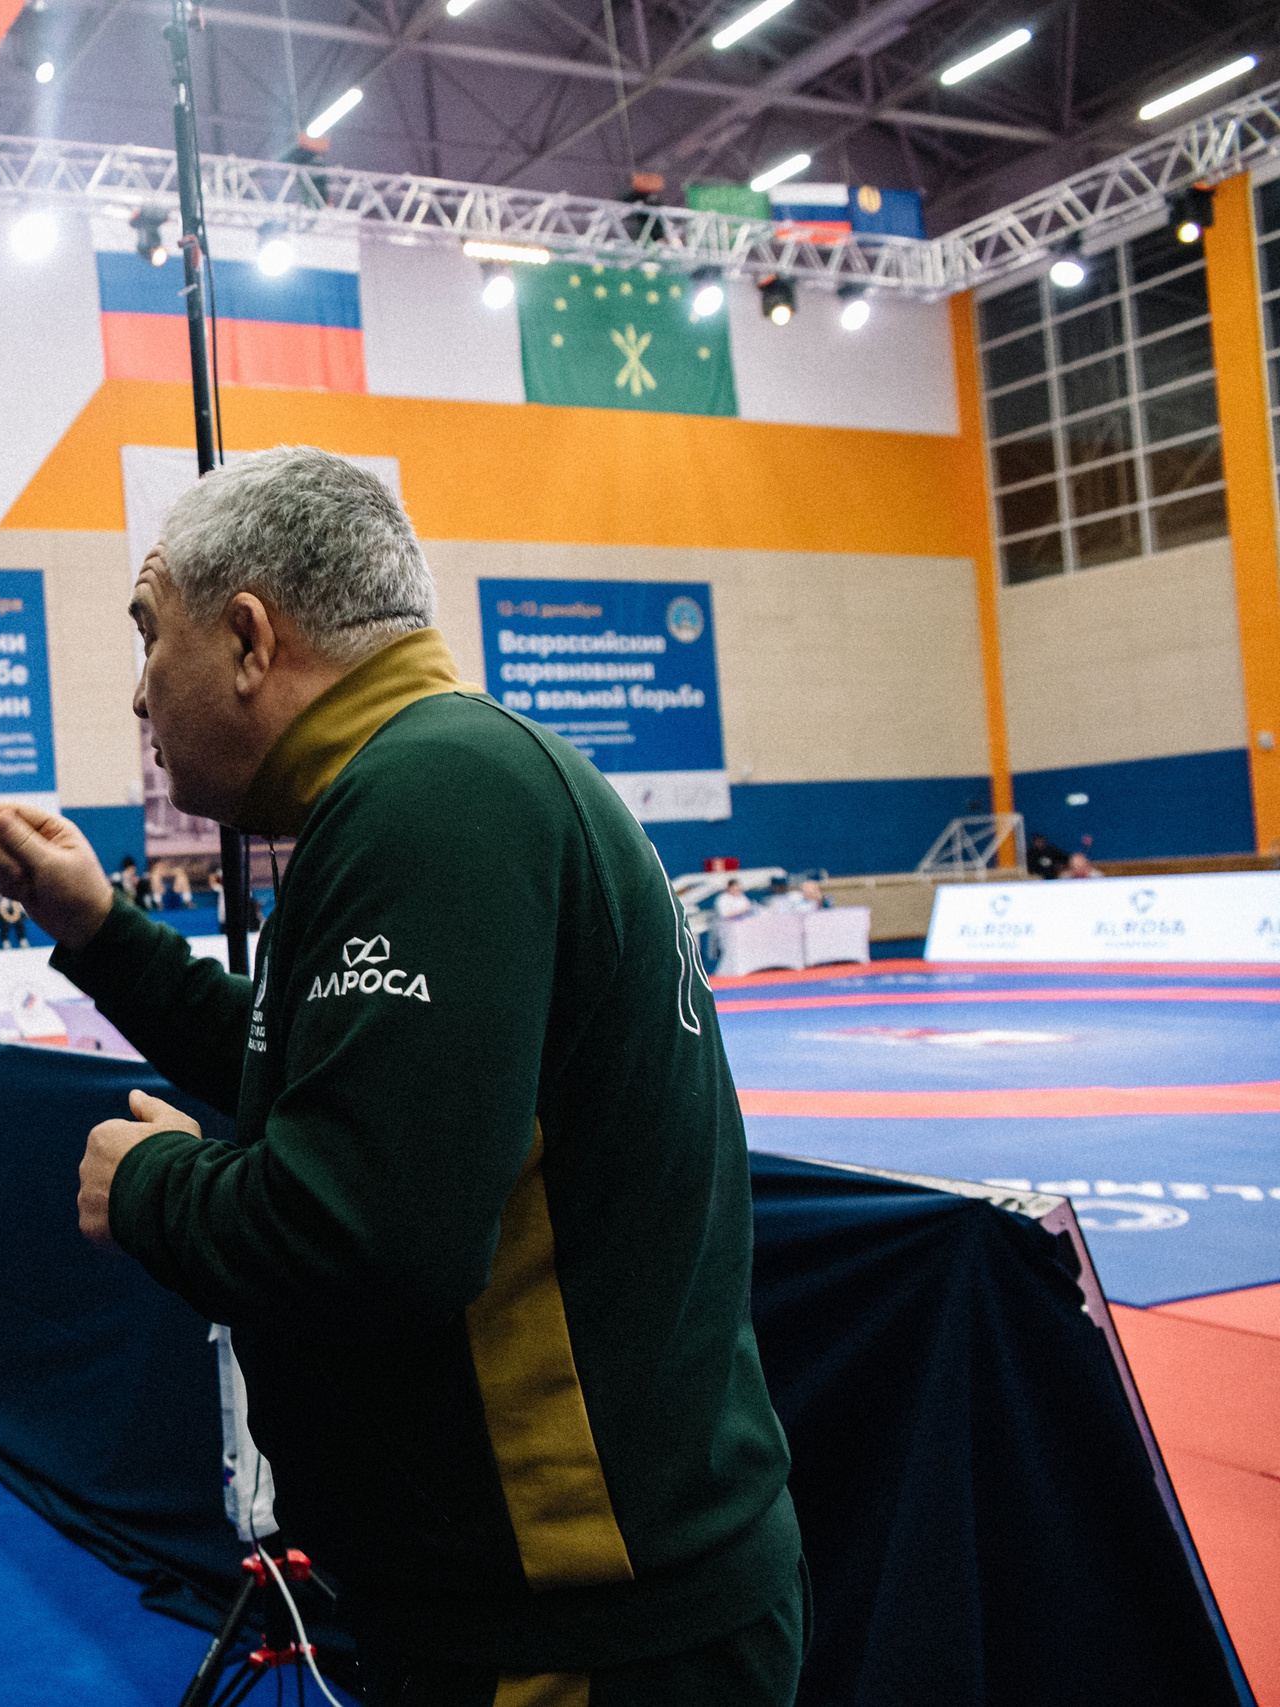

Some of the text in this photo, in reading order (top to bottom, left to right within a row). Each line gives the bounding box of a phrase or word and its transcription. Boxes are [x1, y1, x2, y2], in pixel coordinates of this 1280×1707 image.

[498, 630, 666, 658] Всероссийские
[501, 663, 655, 686] соревнования
[503, 684, 705, 713] по вольной борьбе
[308, 969, 431, 1002] АЛРОСА
